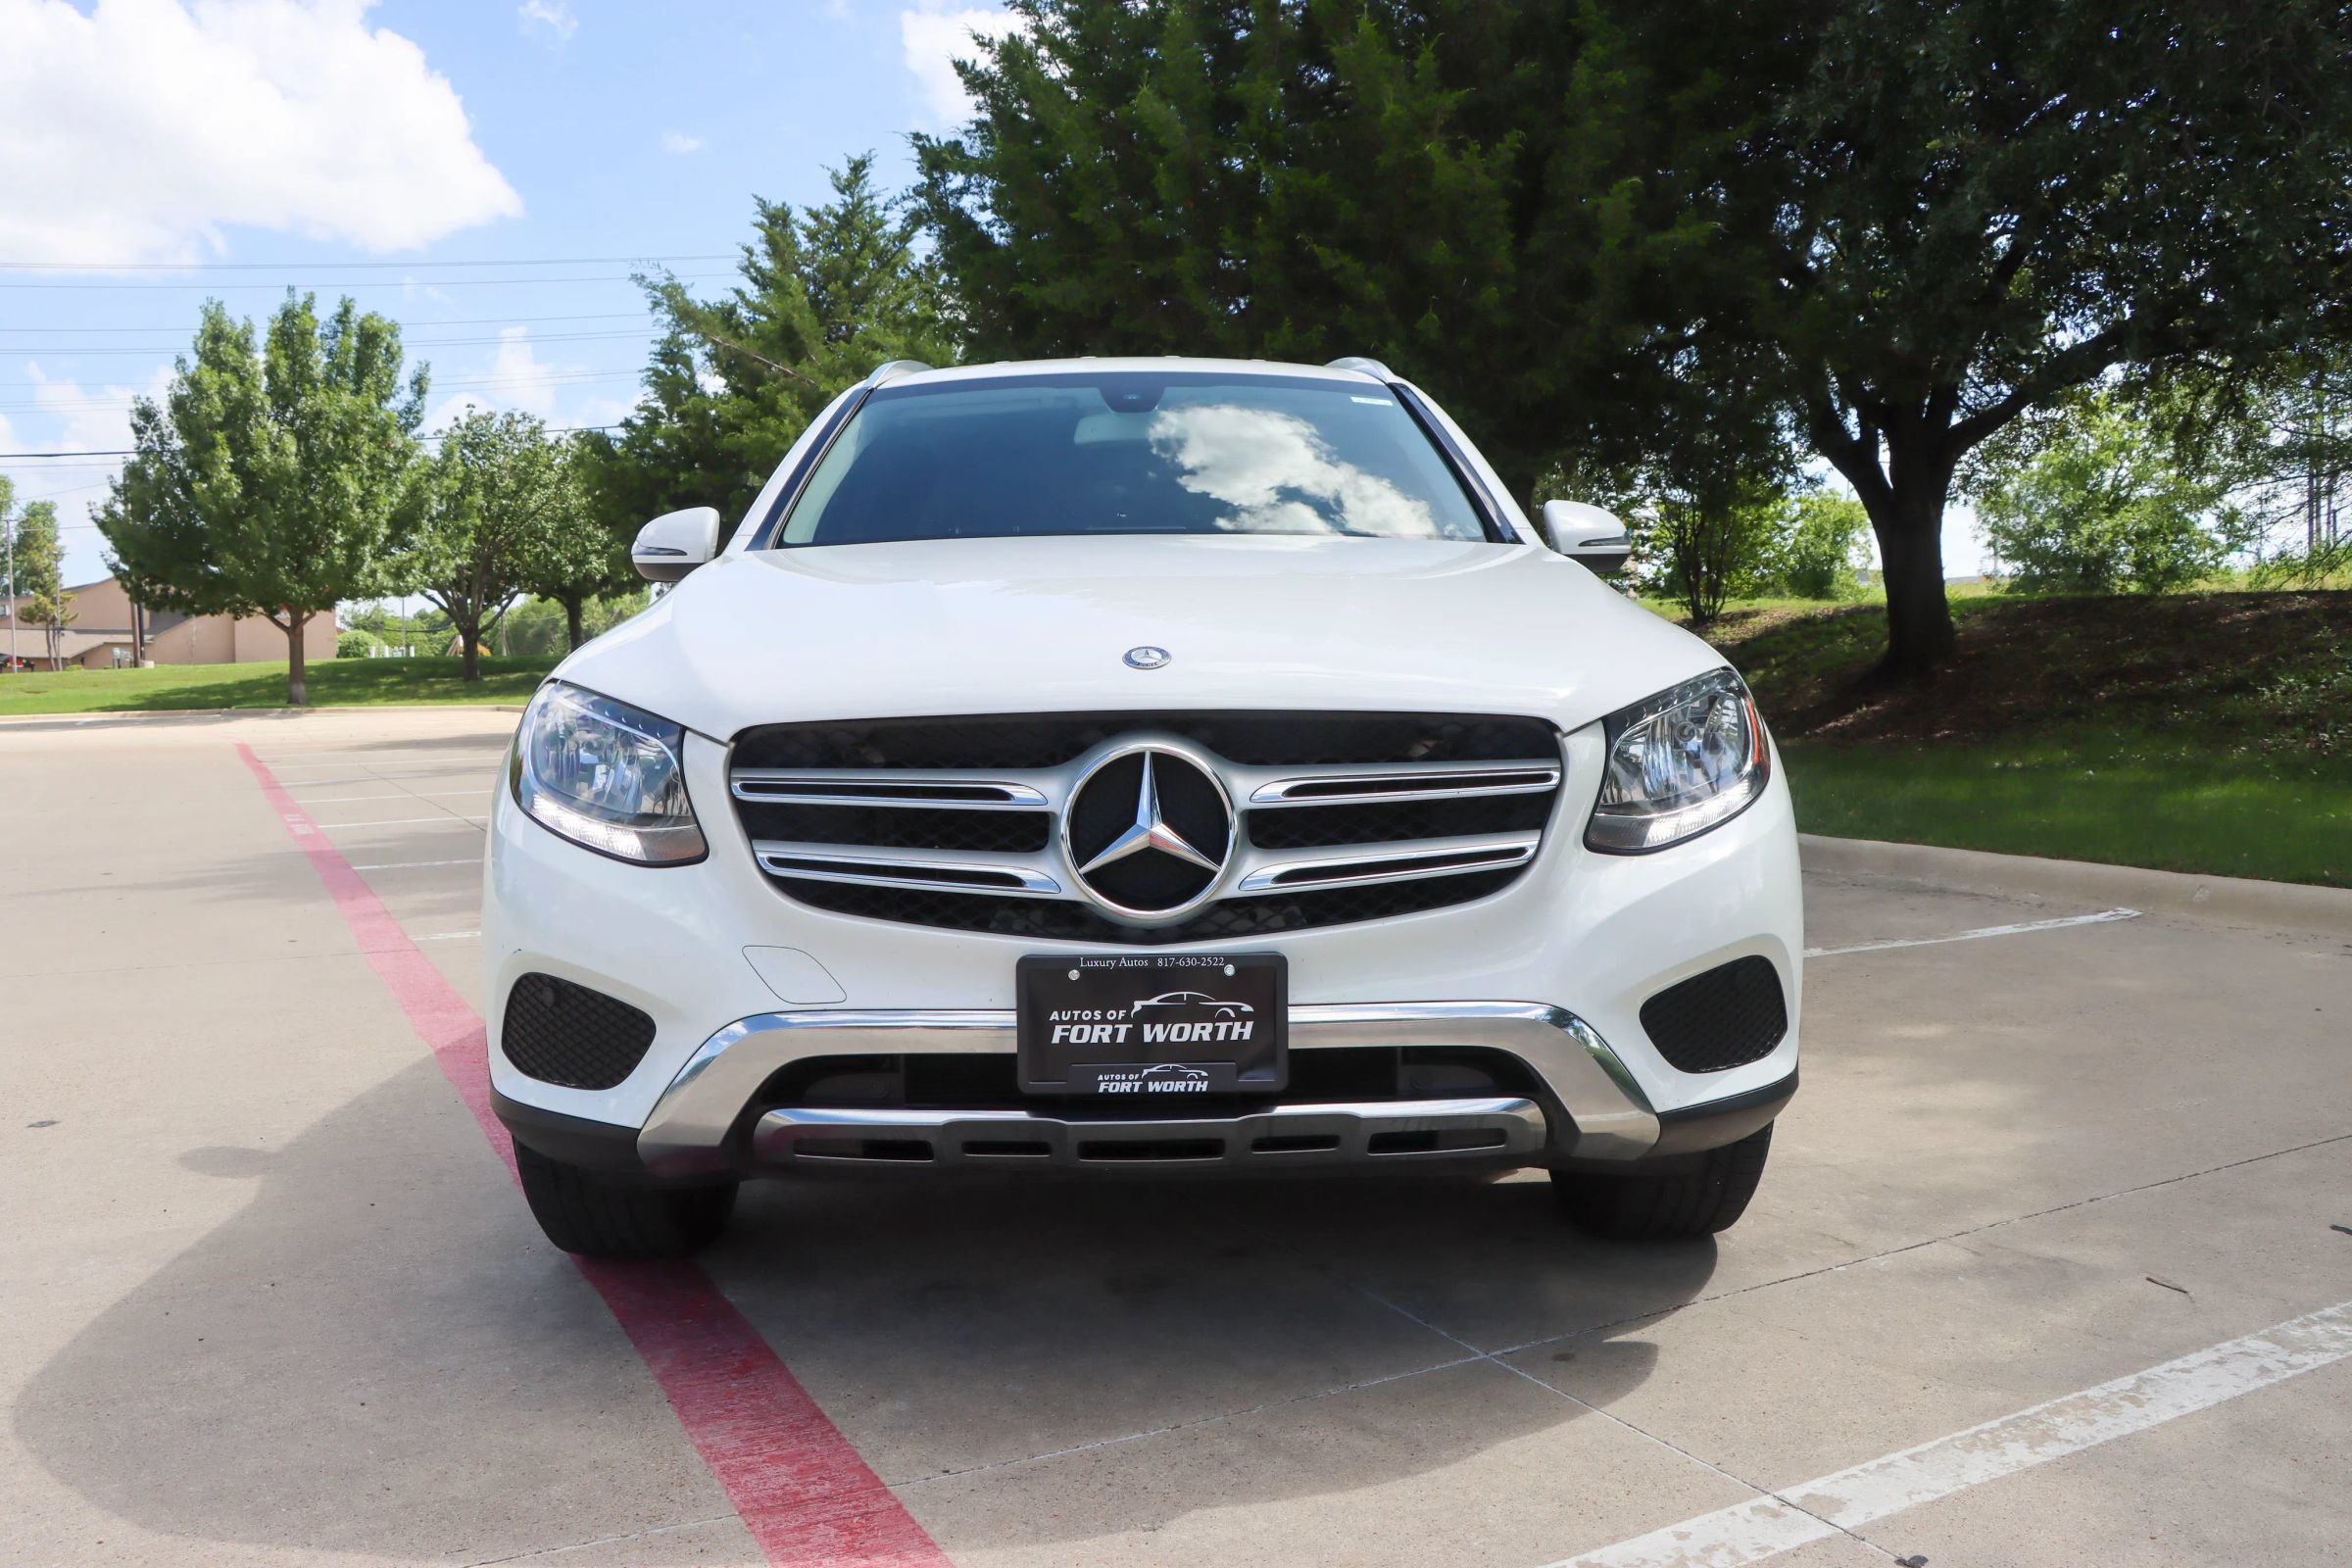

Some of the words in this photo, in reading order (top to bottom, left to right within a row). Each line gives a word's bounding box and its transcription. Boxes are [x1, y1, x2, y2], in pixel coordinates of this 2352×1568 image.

[1080, 956, 1116, 968] Luxury
[1119, 956, 1149, 966] Autos
[1157, 956, 1225, 967] 817-630-2522
[1050, 1010, 1102, 1021] AUTOS
[1106, 1009, 1126, 1020] OF
[1052, 1024, 1133, 1044] FORT
[1144, 1021, 1254, 1042] WORTH
[1099, 1082, 1143, 1093] FORT
[1149, 1081, 1208, 1092] WORTH
